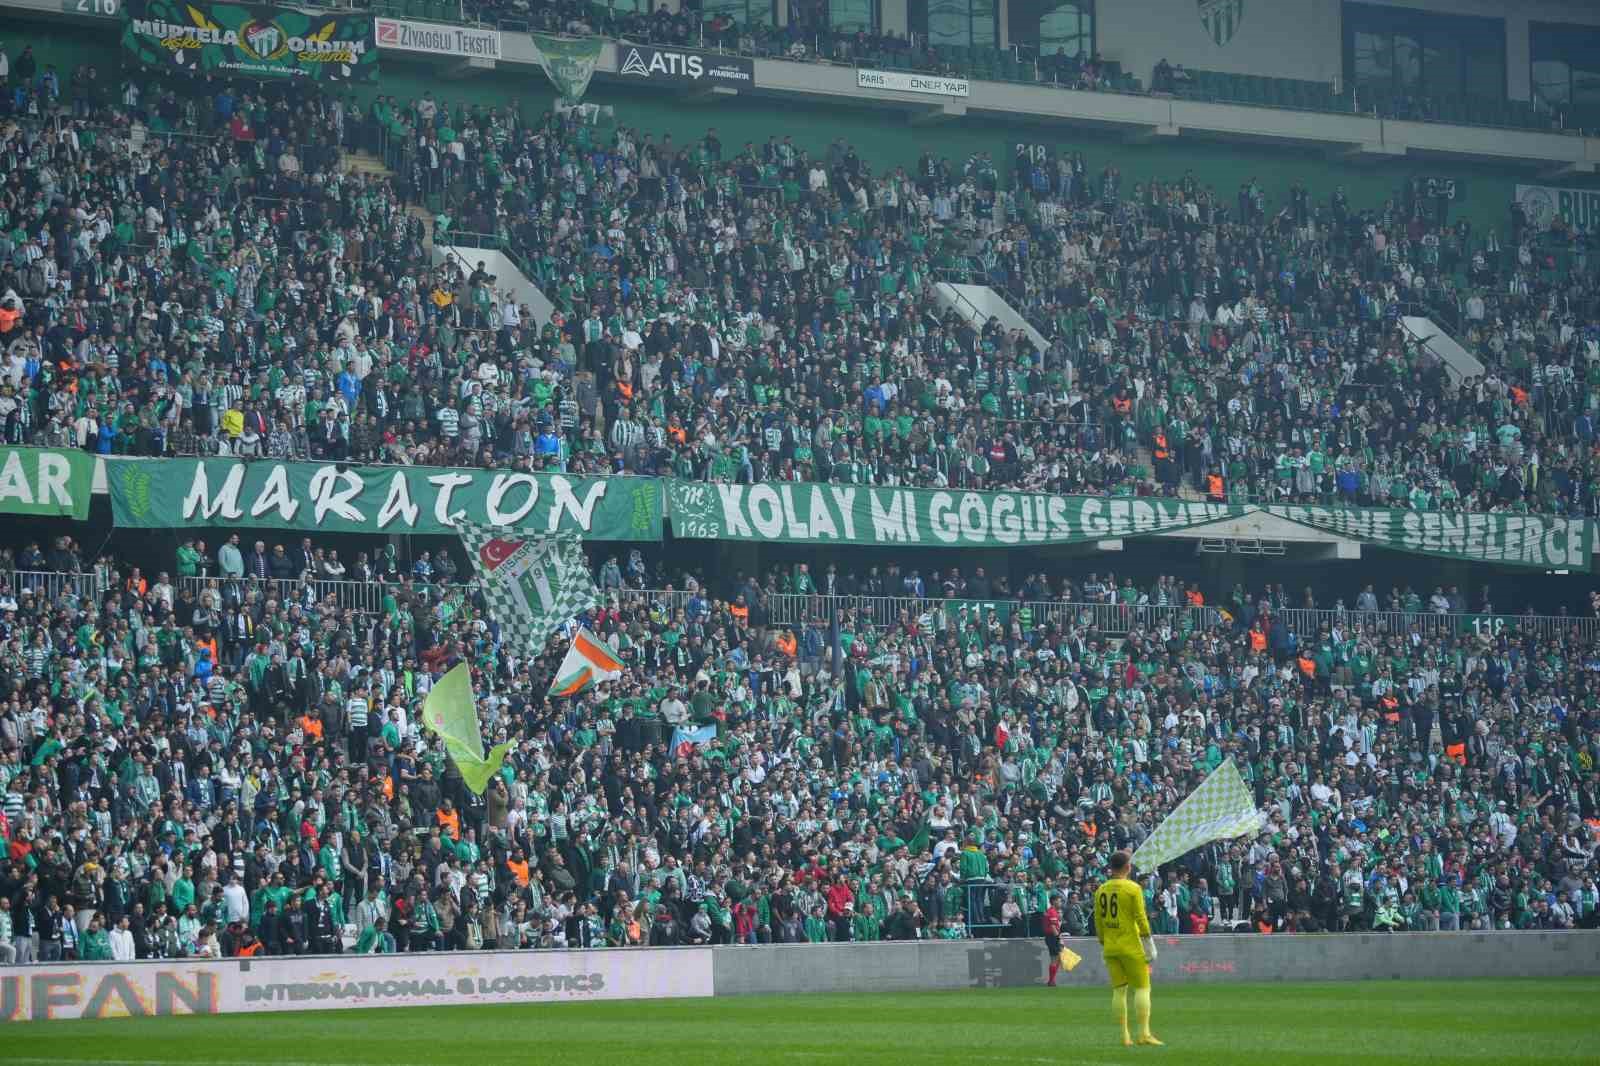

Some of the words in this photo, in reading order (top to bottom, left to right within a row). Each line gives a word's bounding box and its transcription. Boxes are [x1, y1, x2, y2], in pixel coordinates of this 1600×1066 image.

[650, 52, 703, 79] ATIŞ
[183, 461, 607, 531] MARATON
[717, 483, 856, 540] KOLAY
[680, 521, 719, 538] 1963
[1472, 617, 1504, 637] 118
[1100, 893, 1118, 918] 96
[245, 978, 453, 1001] INTERNATIONAL
[478, 973, 605, 994] LOGISTICS
